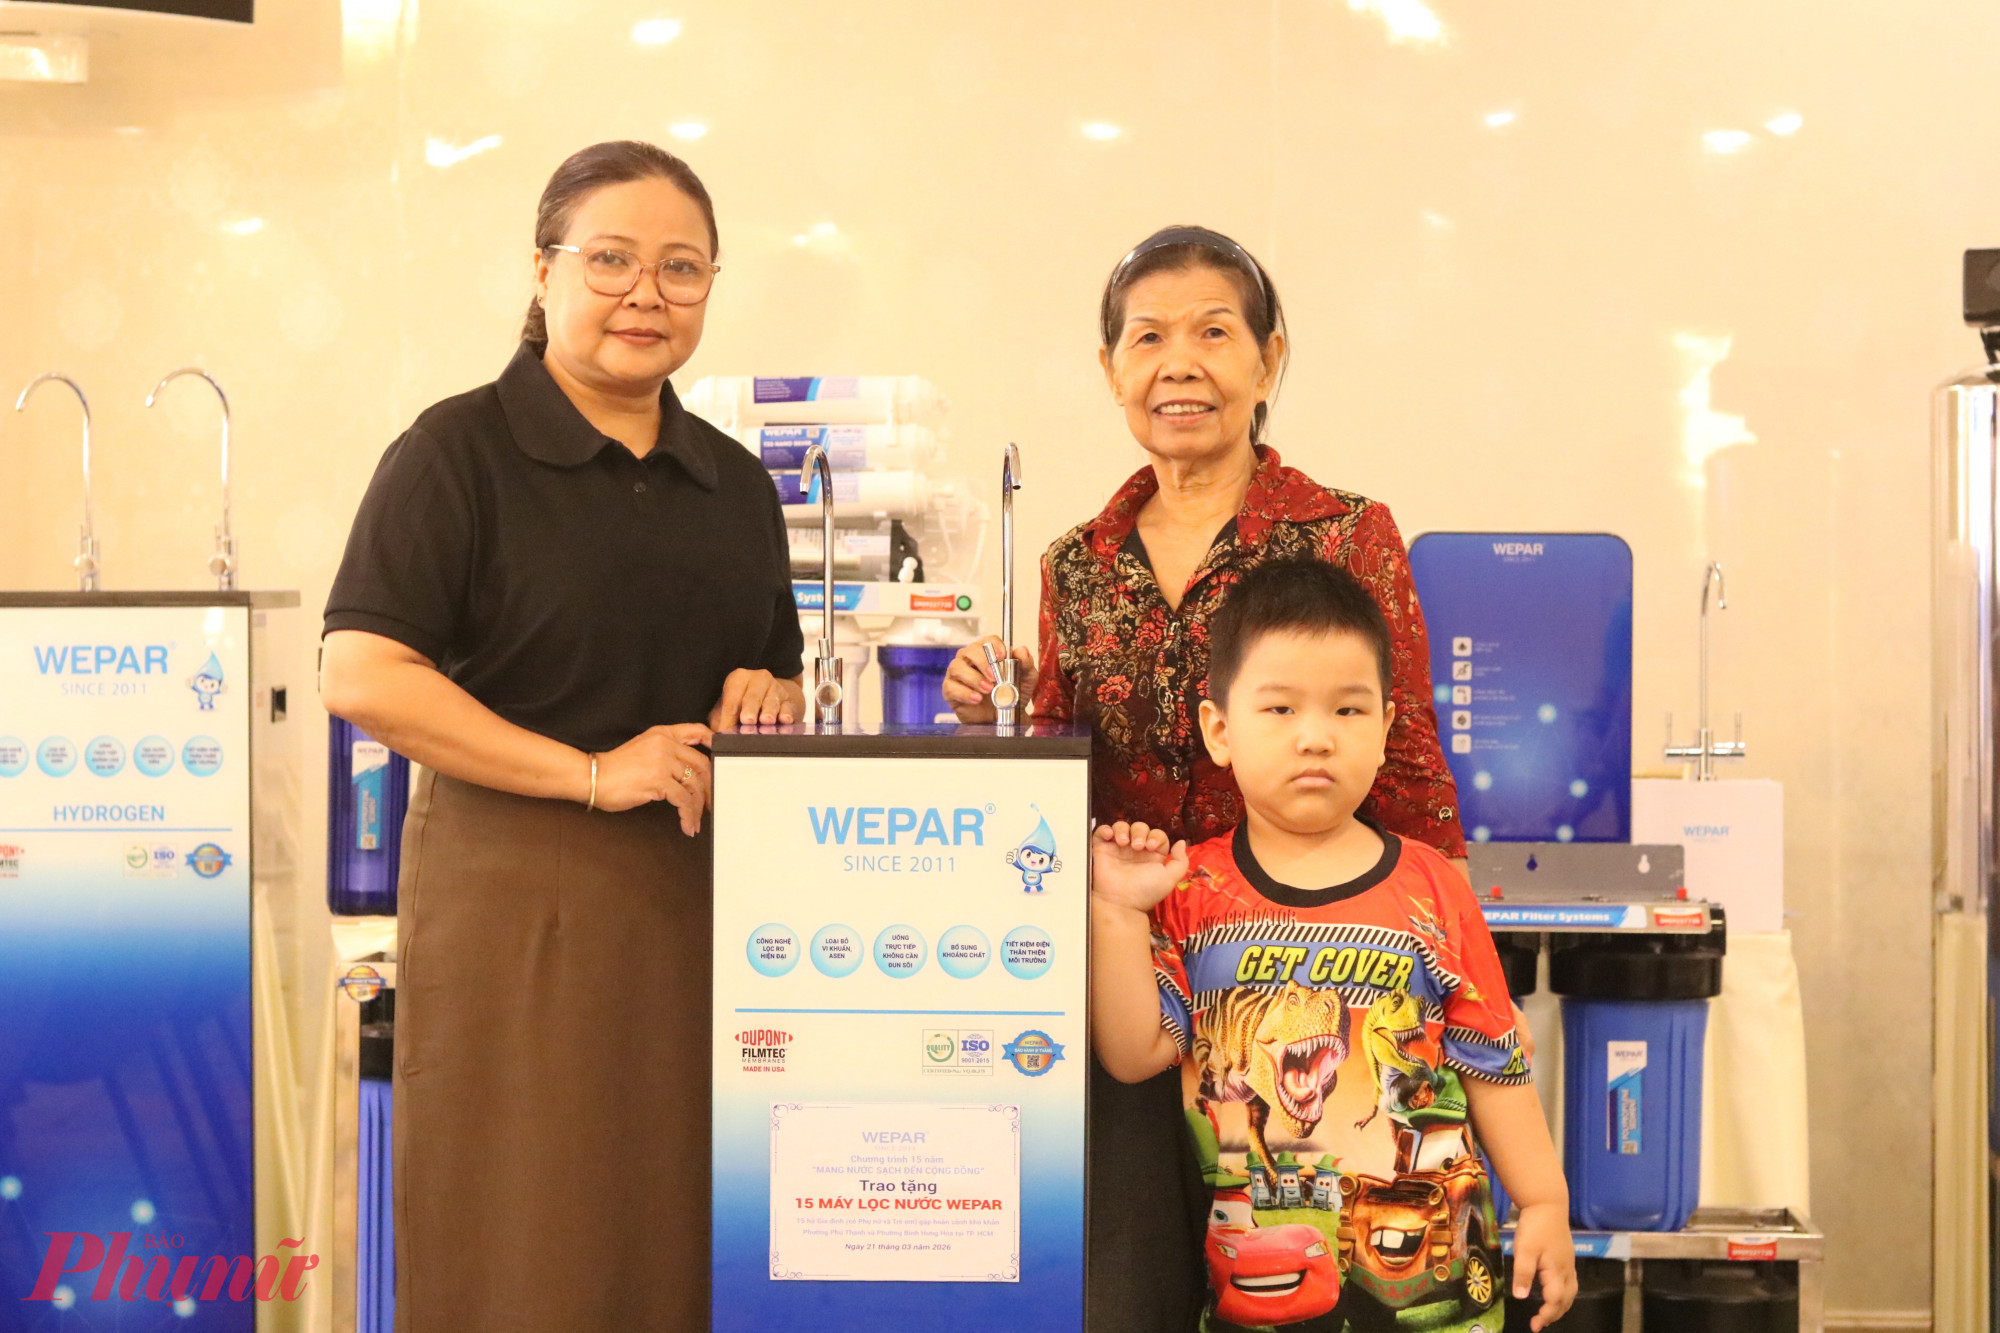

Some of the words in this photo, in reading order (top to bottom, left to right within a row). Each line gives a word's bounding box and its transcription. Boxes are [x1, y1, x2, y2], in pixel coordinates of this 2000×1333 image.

[1493, 543, 1544, 555] WEPAR
[797, 592, 846, 605] Systms
[34, 646, 168, 674] WEPAR
[61, 683, 105, 696] SINCE
[112, 683, 147, 696] 2011
[53, 805, 165, 822] HYDROGEN
[808, 806, 985, 846] WEPAR
[1683, 825, 1729, 836] WEPAR
[154, 851, 174, 860] ISO
[844, 855, 901, 872] SINCE
[910, 856, 956, 872] 2011
[1482, 912, 1518, 920] EPAR
[1522, 912, 1555, 921] Filter
[1559, 913, 1610, 923] Systems
[1235, 945, 1309, 985] GET
[1309, 947, 1414, 993] COVER
[742, 1029, 787, 1046] DUPONT
[961, 1040, 990, 1051] ISO
[742, 1048, 786, 1058] FILMTEC
[862, 1131, 926, 1143] WEPAR
[851, 1155, 884, 1164] Chương
[887, 1155, 908, 1163] trình
[925, 1155, 943, 1163] năm
[847, 1165, 873, 1174] NƯỚC
[876, 1167, 901, 1176] SẠCH
[904, 1165, 922, 1174] ĐẾN
[925, 1166, 951, 1176] CỘNG
[859, 1180, 895, 1192] Trao
[901, 1179, 937, 1194] tặng
[796, 1198, 813, 1209] 15
[818, 1196, 853, 1209] MÁY
[858, 1198, 890, 1212] LỌC
[895, 1196, 941, 1210] NƯỚC
[947, 1200, 1002, 1210] WEPAR
[845, 1243, 864, 1251] Ngày
